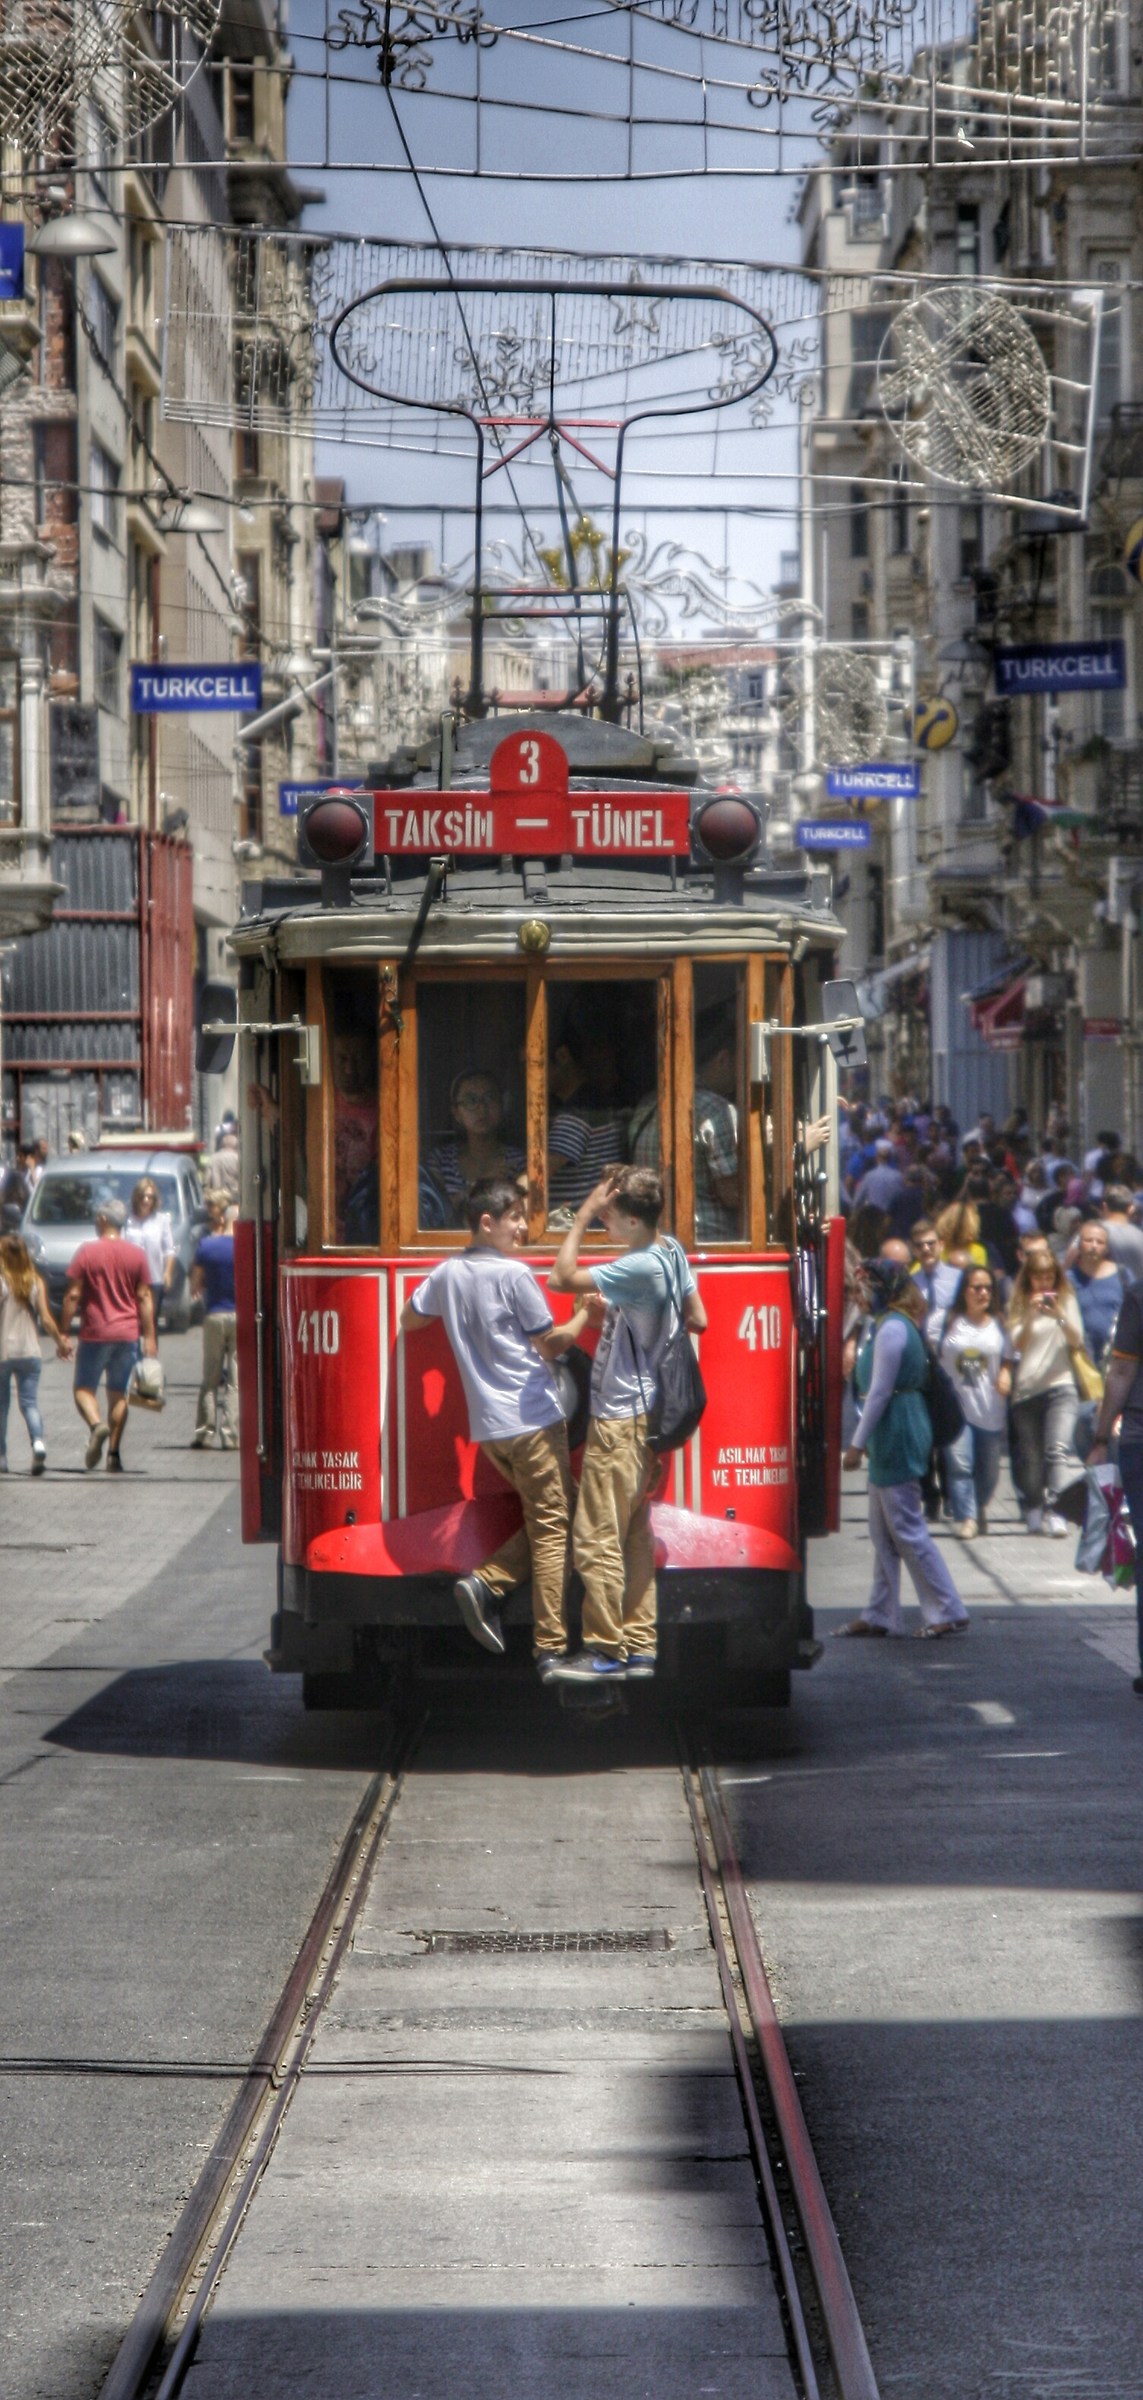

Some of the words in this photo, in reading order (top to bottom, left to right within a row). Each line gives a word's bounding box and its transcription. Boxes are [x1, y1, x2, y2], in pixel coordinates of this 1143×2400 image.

[1001, 654, 1118, 680] TURKCELL
[138, 677, 255, 698] TURKCELL
[519, 740, 540, 784] 3
[833, 771, 915, 789] TURKCELL
[384, 803, 493, 847] TAKSİM
[571, 803, 674, 847] TÜNEL
[801, 826, 867, 840] TURKCELL
[297, 1310, 340, 1354] 410
[738, 1305, 781, 1351] 410
[322, 1451, 359, 1468] YASAK
[718, 1447, 766, 1464] ASILMAK
[712, 1469, 729, 1487] VE
